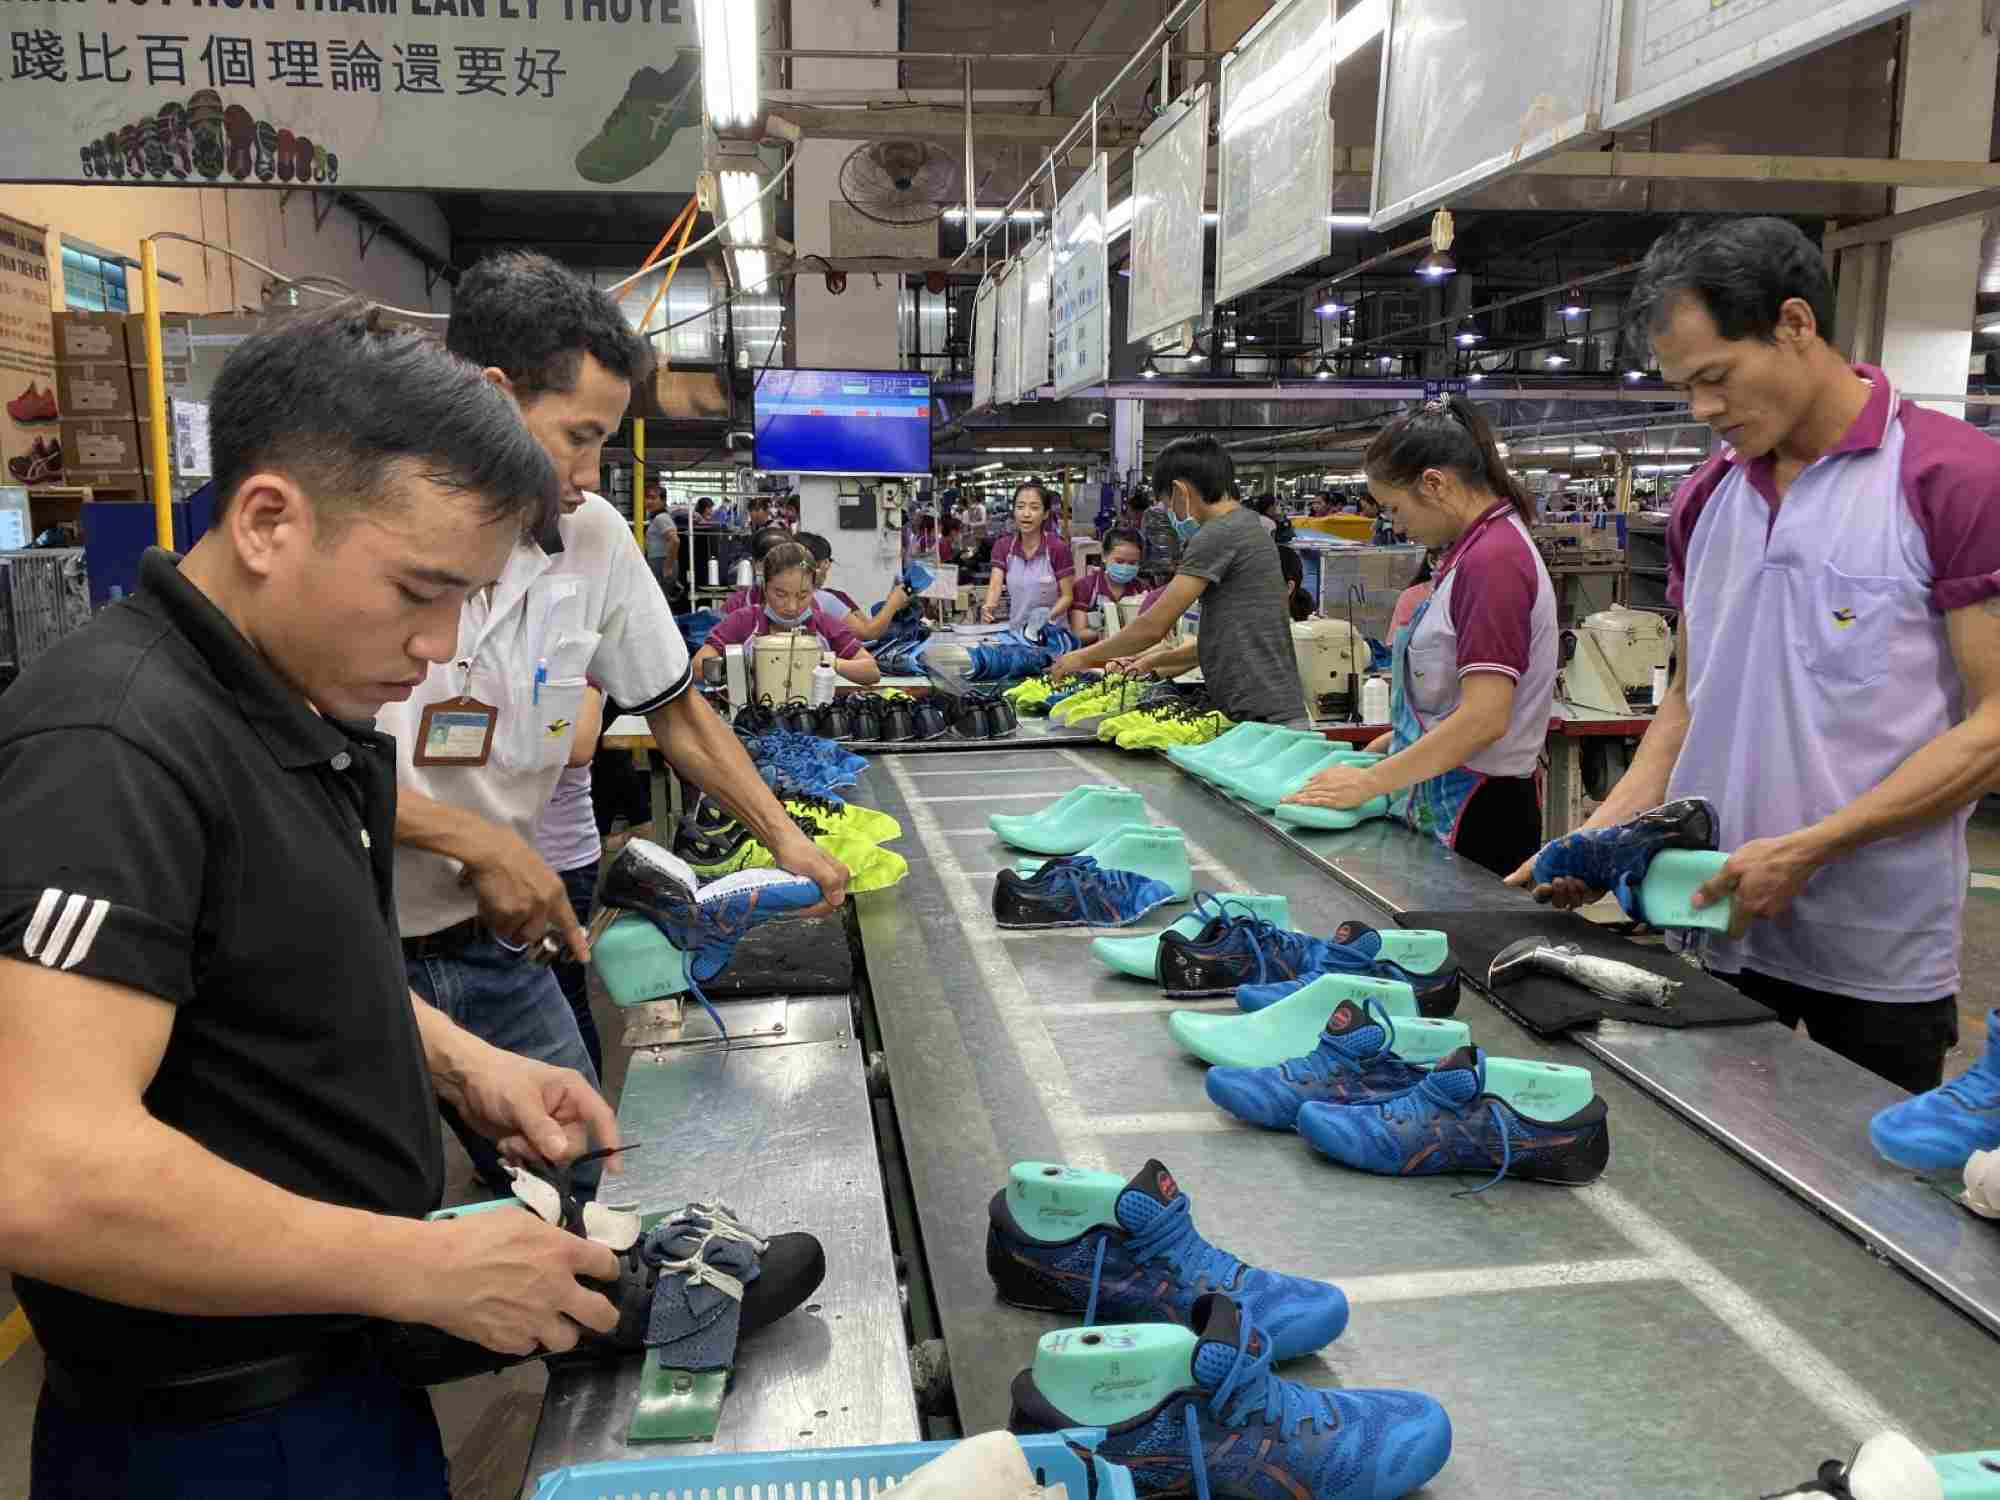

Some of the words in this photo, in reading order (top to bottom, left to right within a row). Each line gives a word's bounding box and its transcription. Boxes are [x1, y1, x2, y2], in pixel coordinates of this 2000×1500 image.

[0, 29, 567, 98] 踐比百個理論還要好
